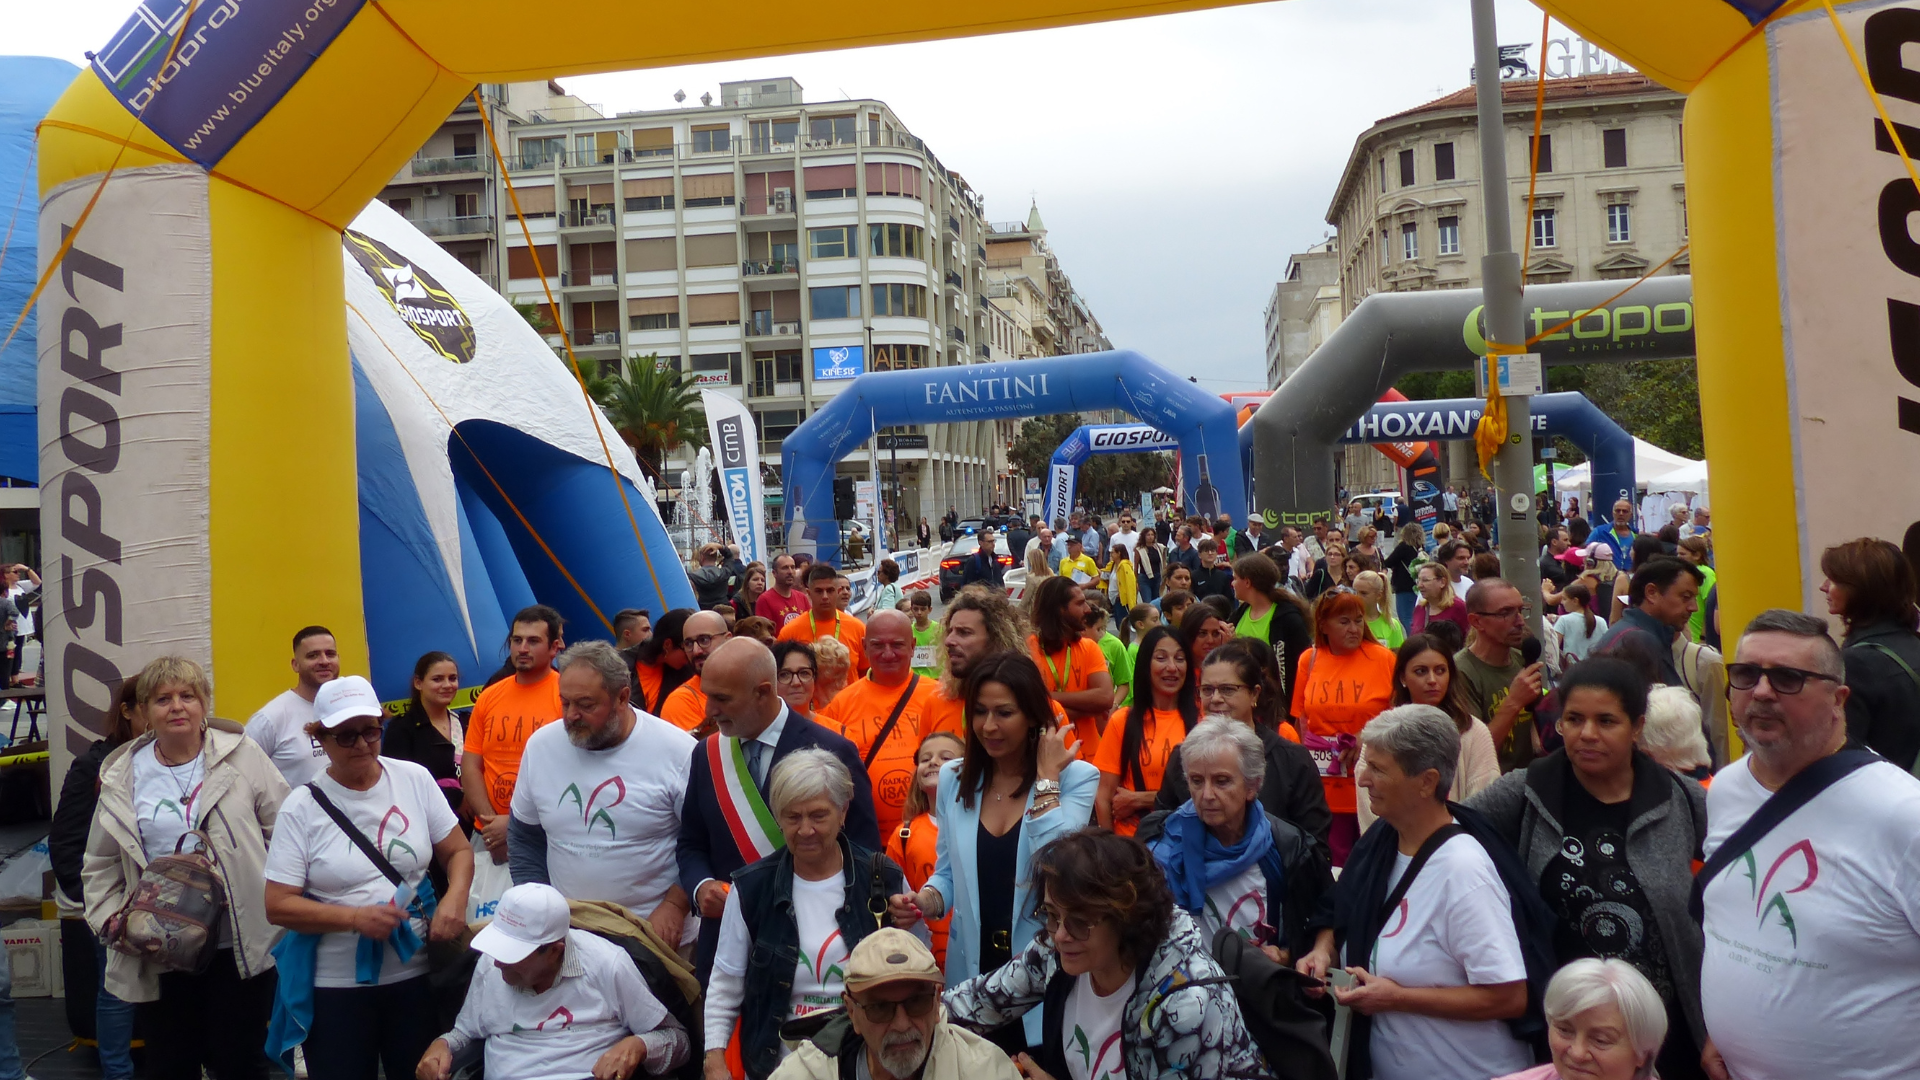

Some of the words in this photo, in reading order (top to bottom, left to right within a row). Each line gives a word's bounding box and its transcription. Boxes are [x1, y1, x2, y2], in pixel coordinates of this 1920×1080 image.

[396, 303, 465, 327] GIOSPORT
[1530, 302, 1692, 341] topo
[1568, 341, 1656, 352] athletic
[822, 367, 855, 376] KINESIS
[968, 366, 1007, 375] VINI
[924, 373, 1050, 405] FANTINI
[945, 405, 994, 416] AUTENTICA
[995, 402, 1036, 413] PASSIONE
[723, 422, 741, 463] CLUB
[1094, 430, 1178, 447] GIOSPOR
